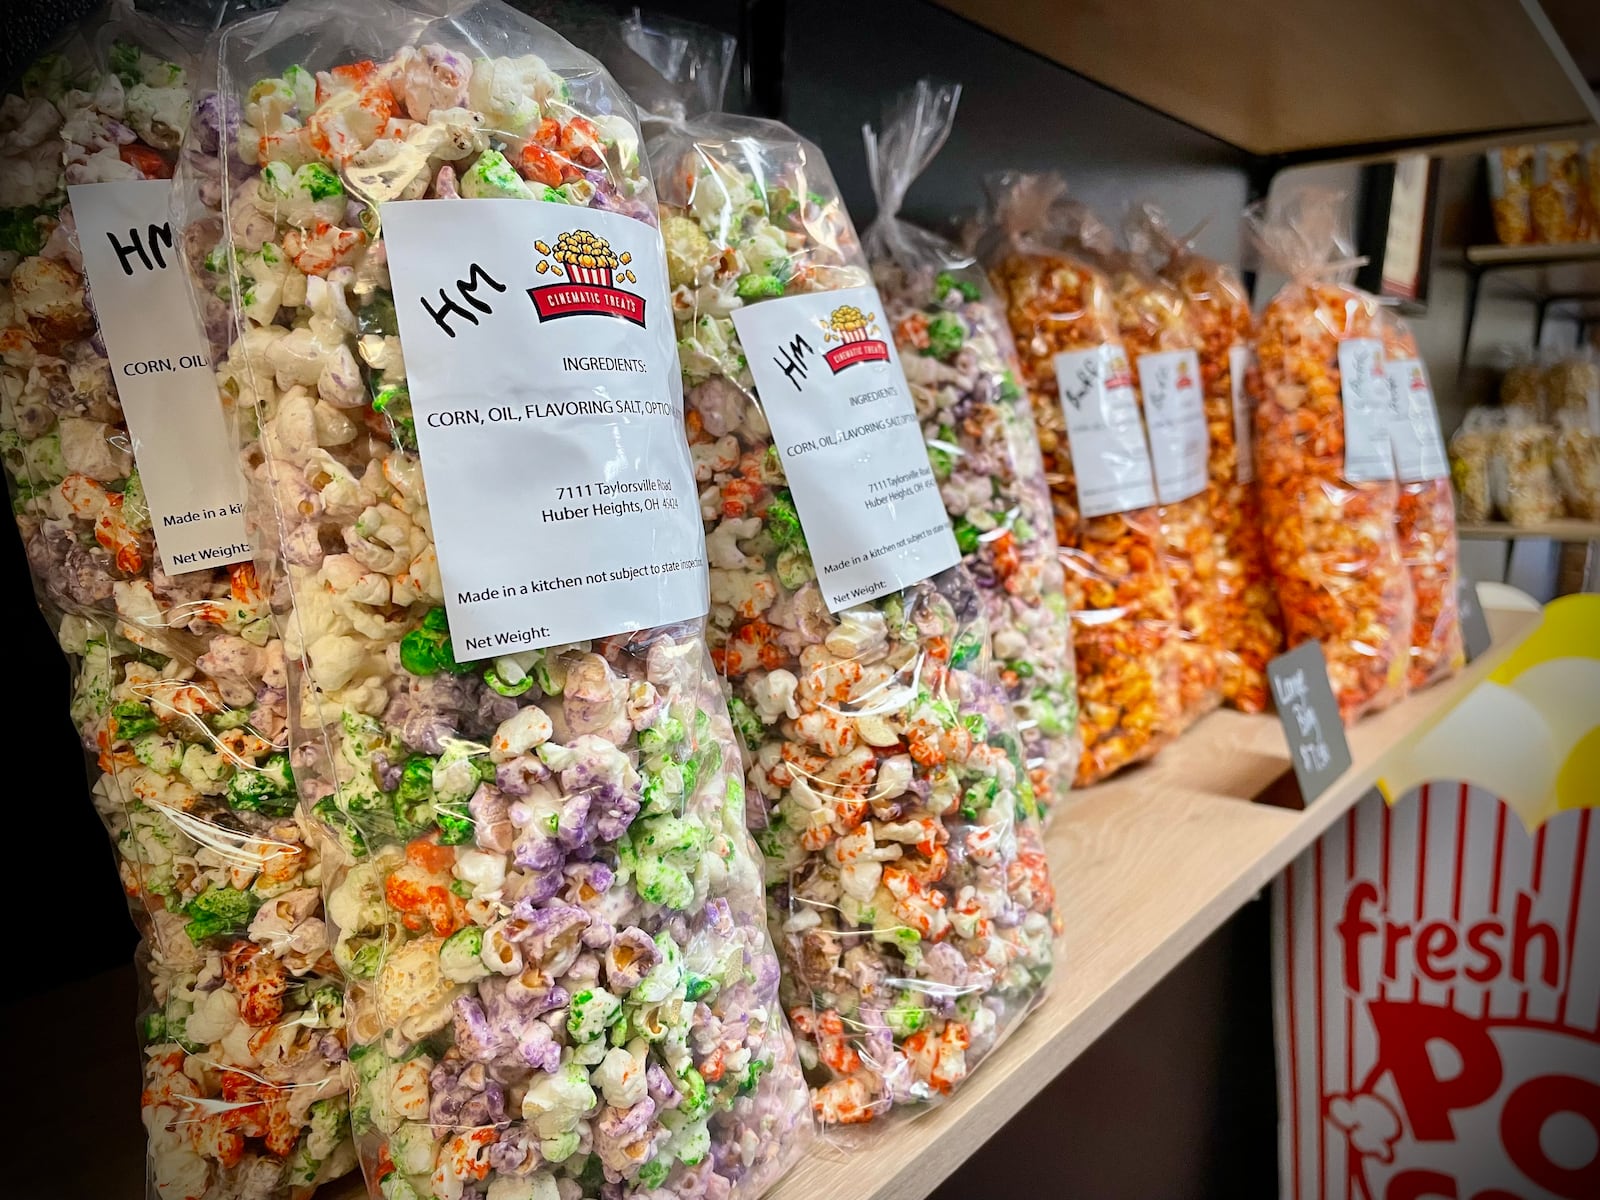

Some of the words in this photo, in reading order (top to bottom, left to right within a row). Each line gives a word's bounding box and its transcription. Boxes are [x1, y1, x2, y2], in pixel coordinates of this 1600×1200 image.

[420, 263, 507, 338] HM
[546, 291, 601, 307] CINEMATIC
[603, 294, 636, 313] TREATS
[123, 358, 176, 376] CORN,
[562, 357, 647, 373] INGREDIENTS:
[773, 333, 815, 392] HM
[427, 409, 485, 428] CORN,
[488, 406, 522, 423] OIL,
[525, 399, 613, 419] FLAVORING
[615, 399, 644, 415] SALT,
[787, 440, 819, 457] CORN,
[819, 435, 837, 447] OIL,
[555, 485, 592, 500] 7111
[595, 479, 656, 498] Taylorsville
[657, 478, 672, 491] Road
[868, 480, 888, 493] 7111
[541, 507, 589, 523] Huber
[592, 500, 643, 517] Heights,
[644, 498, 660, 511] OH
[864, 496, 888, 509] Huber
[163, 510, 200, 526] Made
[203, 507, 216, 520] in
[219, 506, 227, 516] a
[172, 551, 197, 565] Net
[198, 543, 251, 560] Weight:
[824, 560, 850, 574] Made
[851, 555, 861, 565] in
[863, 553, 869, 561] a
[869, 543, 896, 559] kitchen
[896, 538, 907, 548] not
[457, 588, 500, 604] Made
[502, 584, 516, 597] in
[519, 584, 528, 595] a
[530, 575, 583, 593] kitchen
[585, 571, 608, 585] not
[610, 564, 649, 580] subject
[650, 565, 660, 575] to
[661, 560, 680, 573] state
[833, 593, 850, 605] Net
[850, 580, 888, 598] Weight:
[465, 637, 493, 650] Net
[494, 626, 551, 646] Weight:
[1337, 881, 1560, 994] fresh
